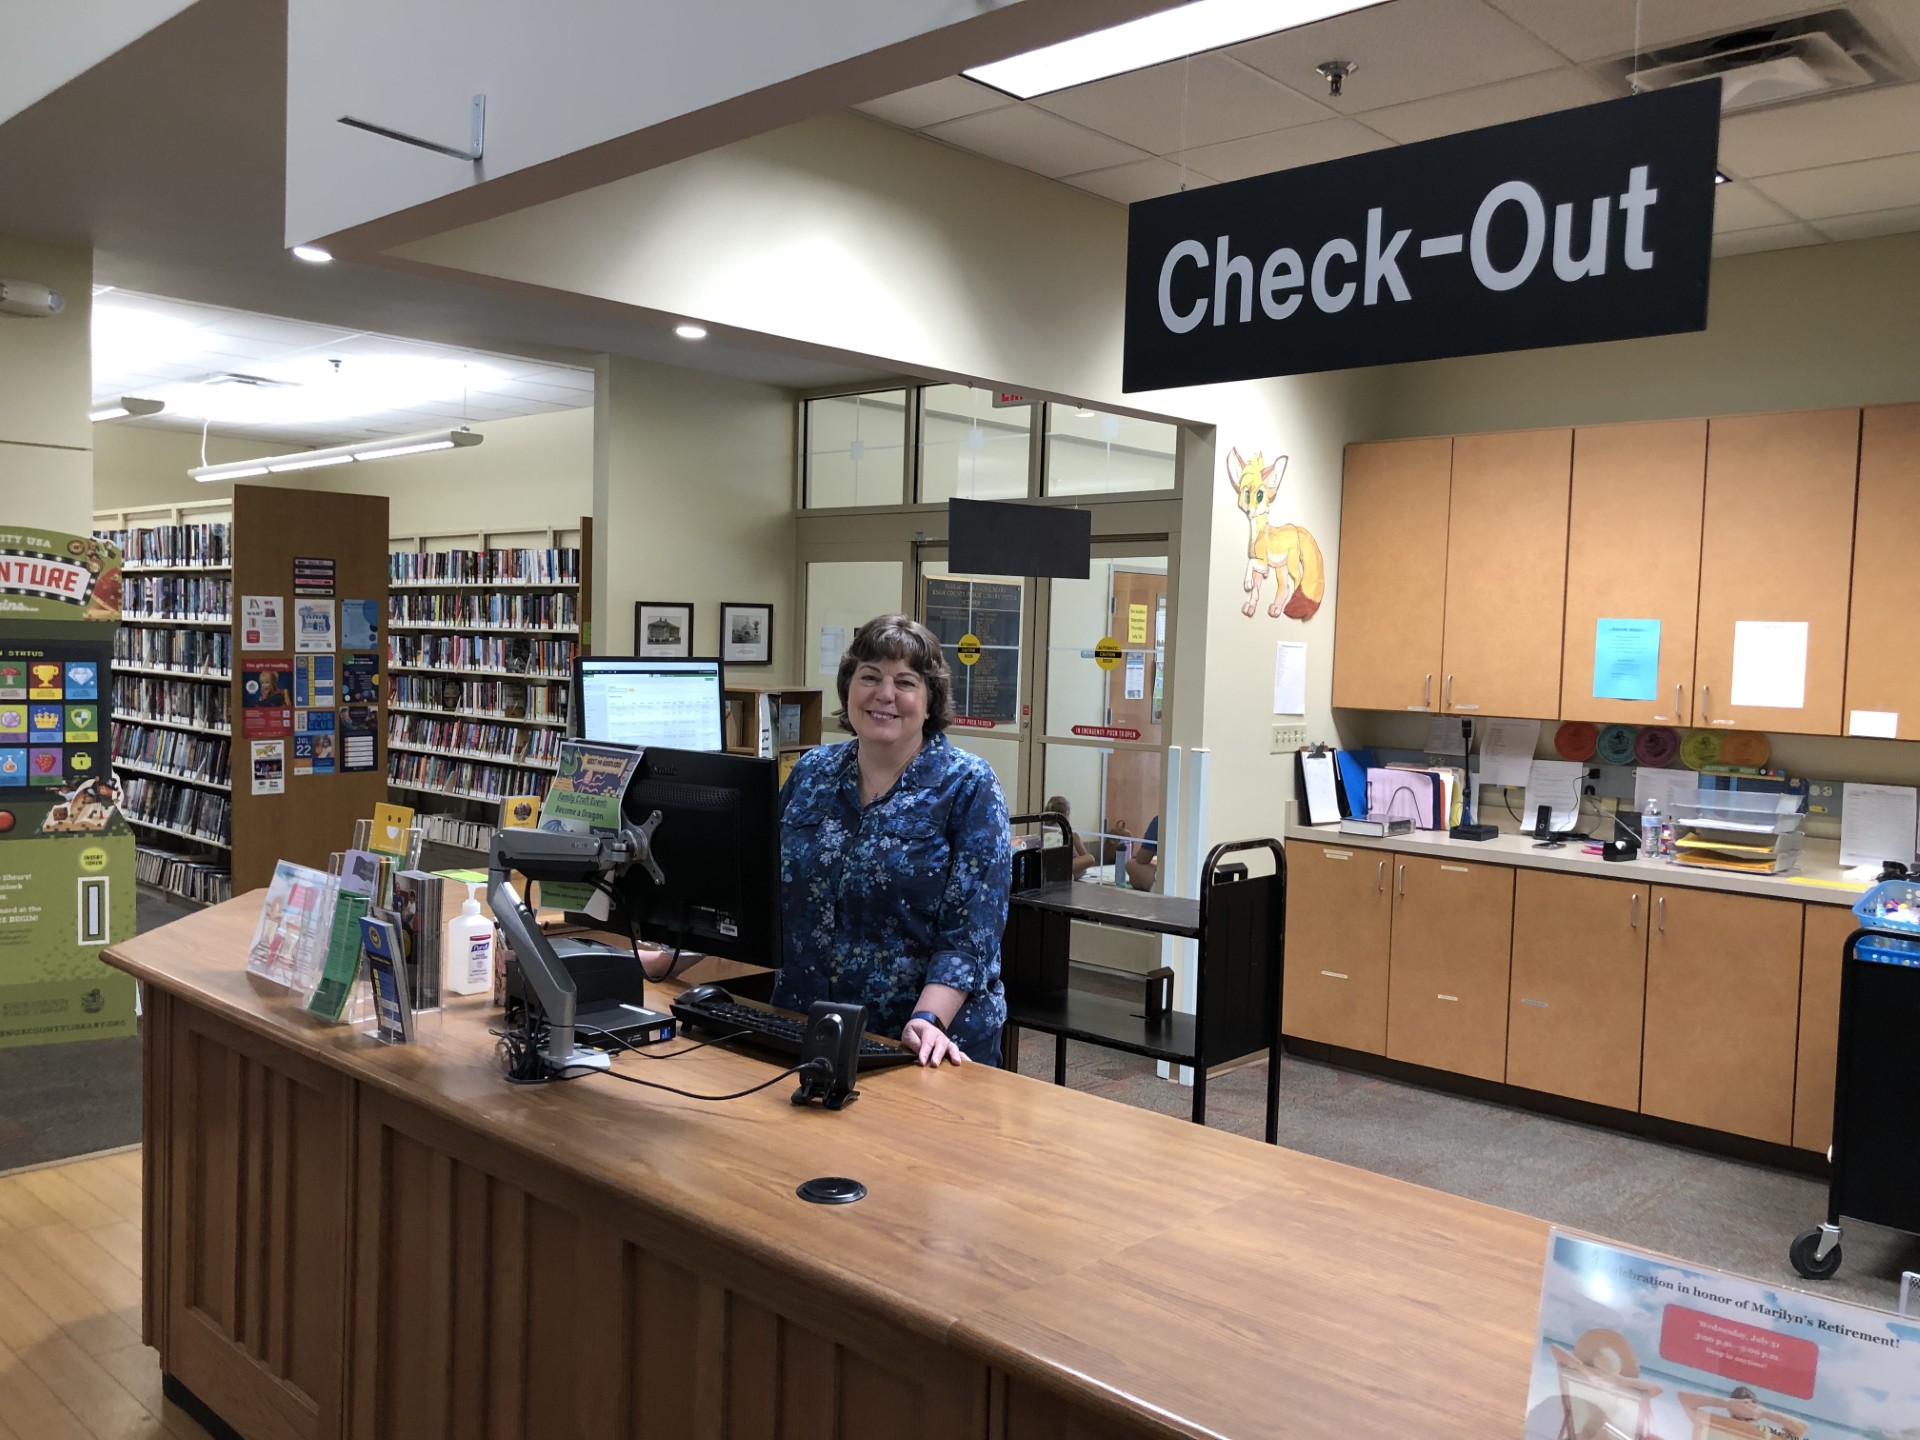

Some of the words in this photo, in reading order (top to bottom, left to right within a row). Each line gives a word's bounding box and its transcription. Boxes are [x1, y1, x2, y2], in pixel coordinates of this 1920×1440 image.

[1157, 165, 1658, 334] Check-Out
[26, 536, 52, 548] USA
[308, 712, 333, 721] BOOK
[308, 721, 334, 729] CLUB
[1081, 727, 1105, 735] EMERGENCY
[296, 737, 309, 745] JUL
[296, 745, 312, 757] 22
[557, 792, 575, 804] Family
[575, 794, 589, 805] Craft
[555, 805, 577, 816] Become
[581, 809, 604, 821] Dragon
[1677, 1281, 1690, 1294] in
[1692, 1285, 1733, 1306] honor
[1734, 1299, 1750, 1312] of
[1750, 1301, 1815, 1328] Marilyn's
[1817, 1318, 1901, 1350] Retirement!
